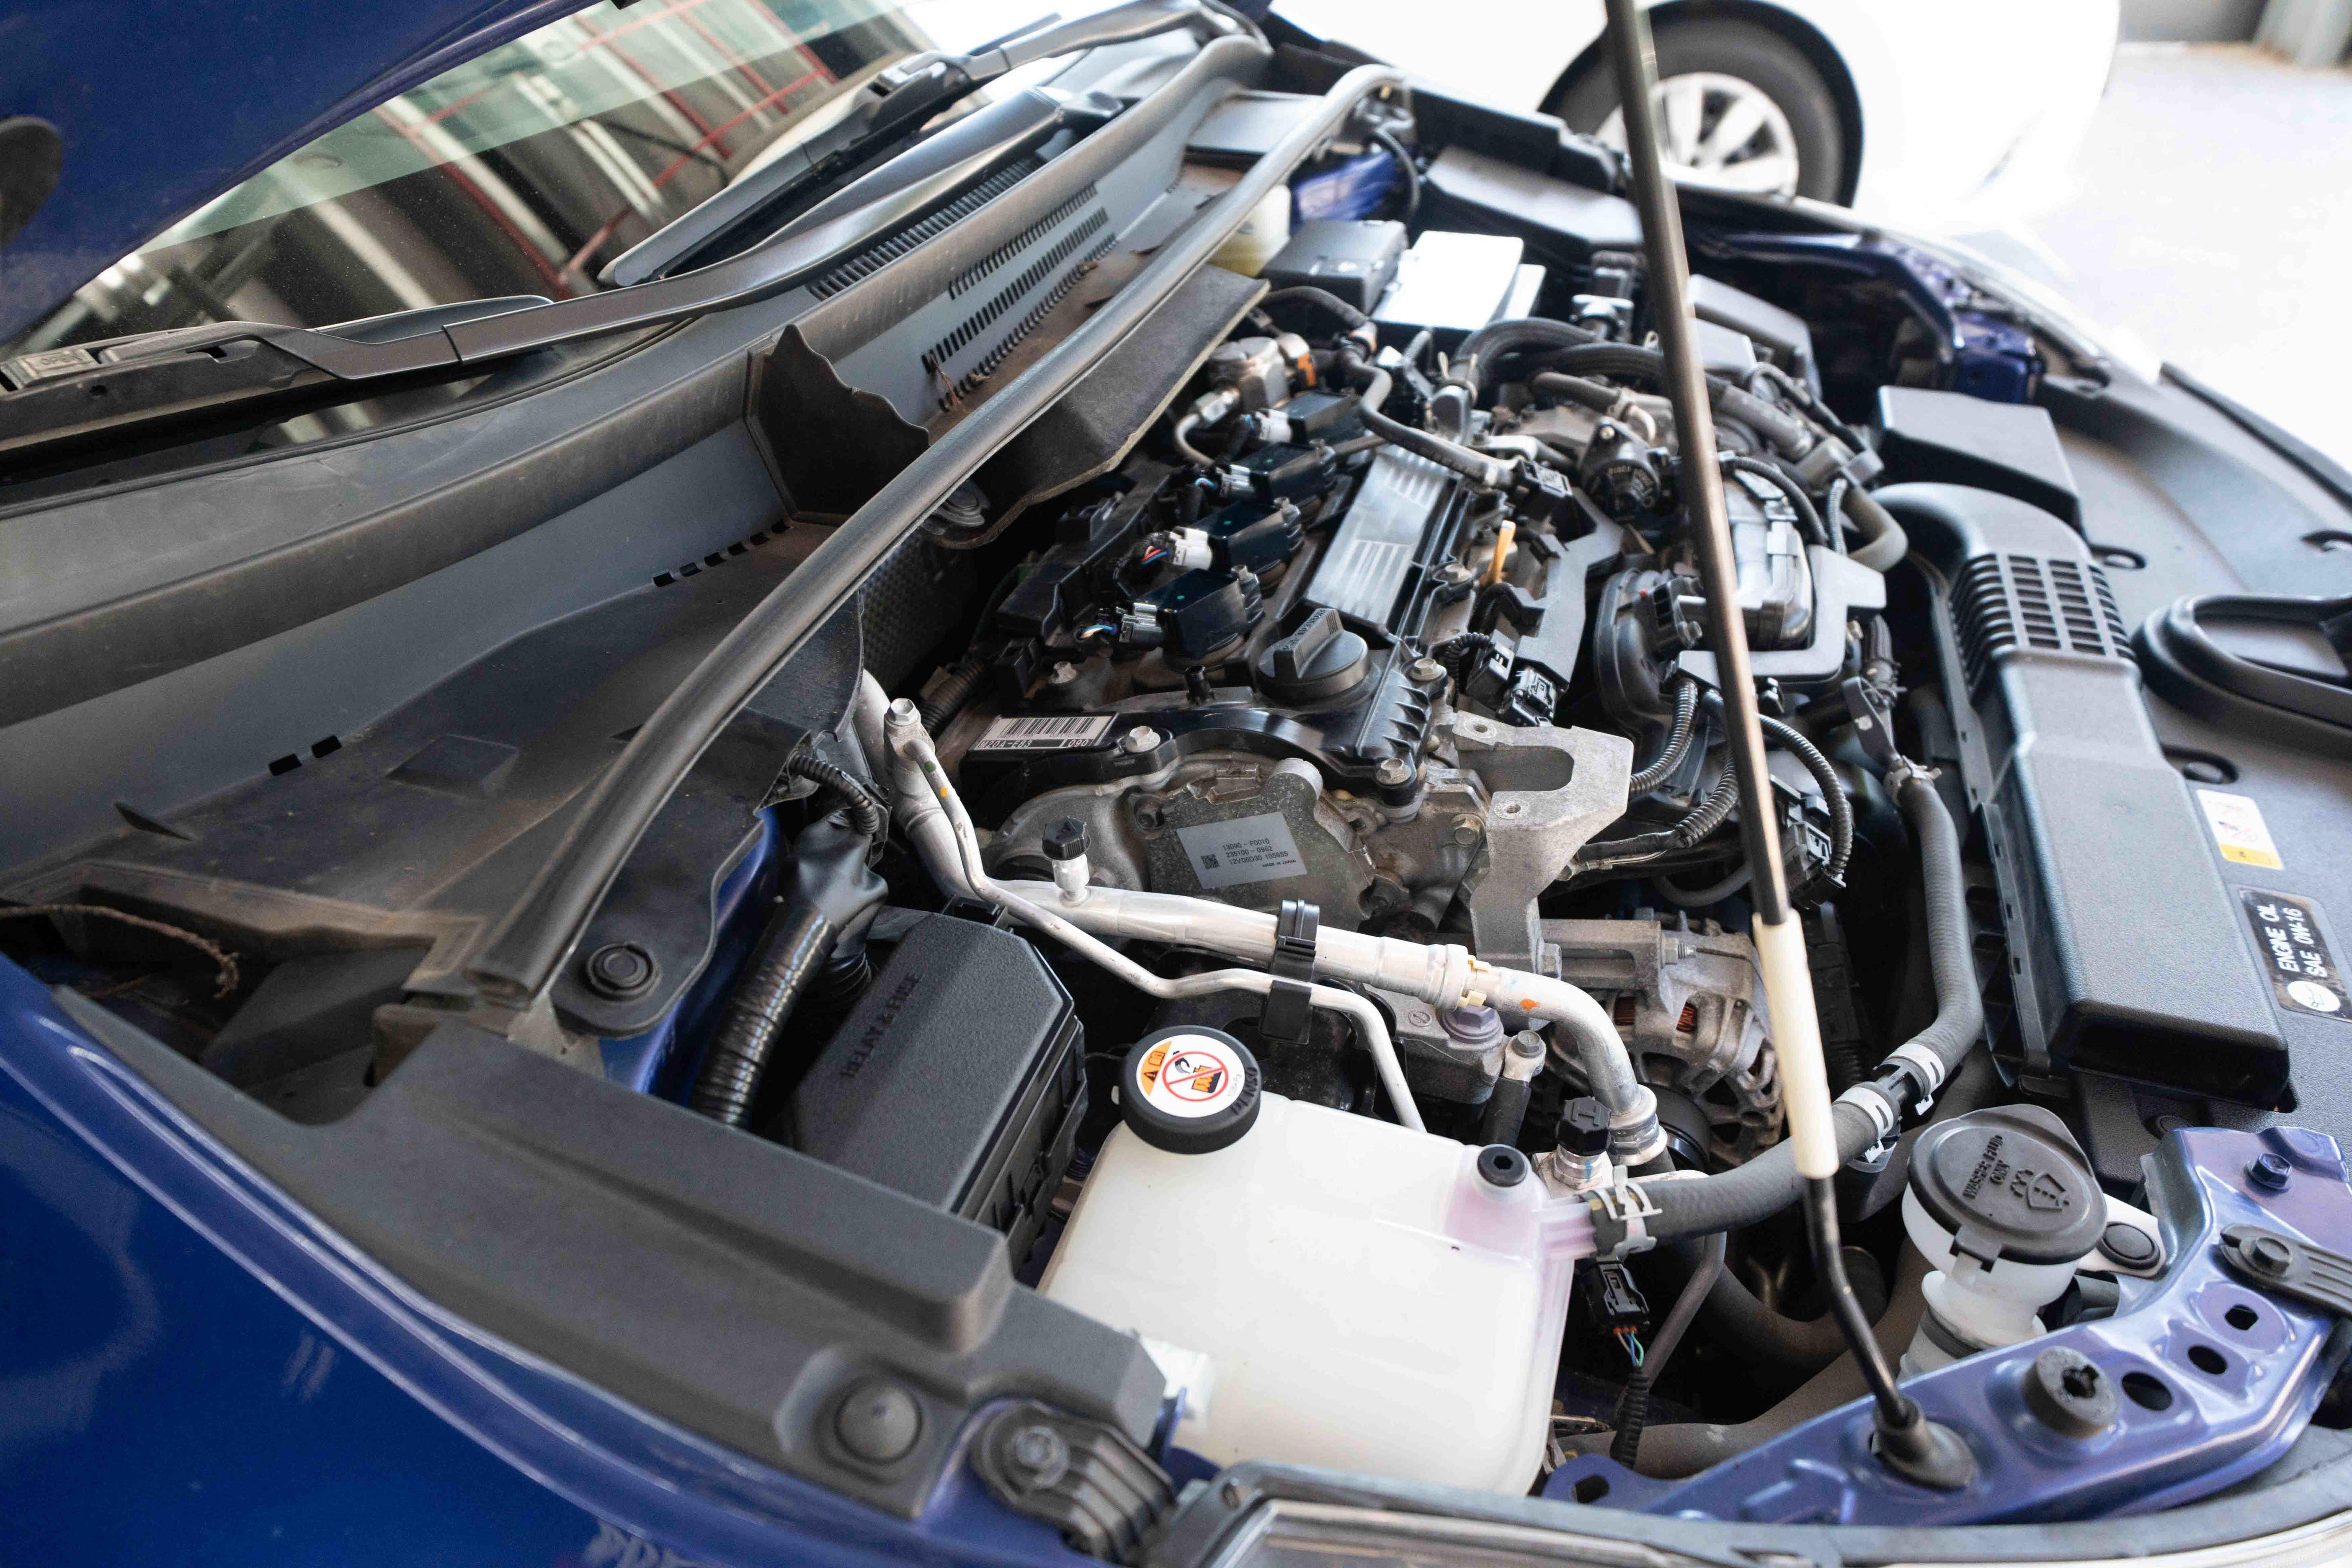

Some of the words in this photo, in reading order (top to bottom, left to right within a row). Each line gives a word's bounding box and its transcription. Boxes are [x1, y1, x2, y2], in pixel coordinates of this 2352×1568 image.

[1068, 739, 1089, 747] 090
[1223, 842, 1242, 851] 13090
[1250, 838, 1270, 846] F0010
[1226, 849, 1249, 858] 235100
[2256, 903, 2280, 922] OIL
[2283, 907, 2315, 945] 0W-16
[2264, 926, 2300, 972] ENGINE
[2299, 950, 2328, 978] SAE
[1229, 1067, 1258, 1115] DENSO
[1571, 1101, 1601, 1127] H
[1962, 1160, 1992, 1199] WASHER
